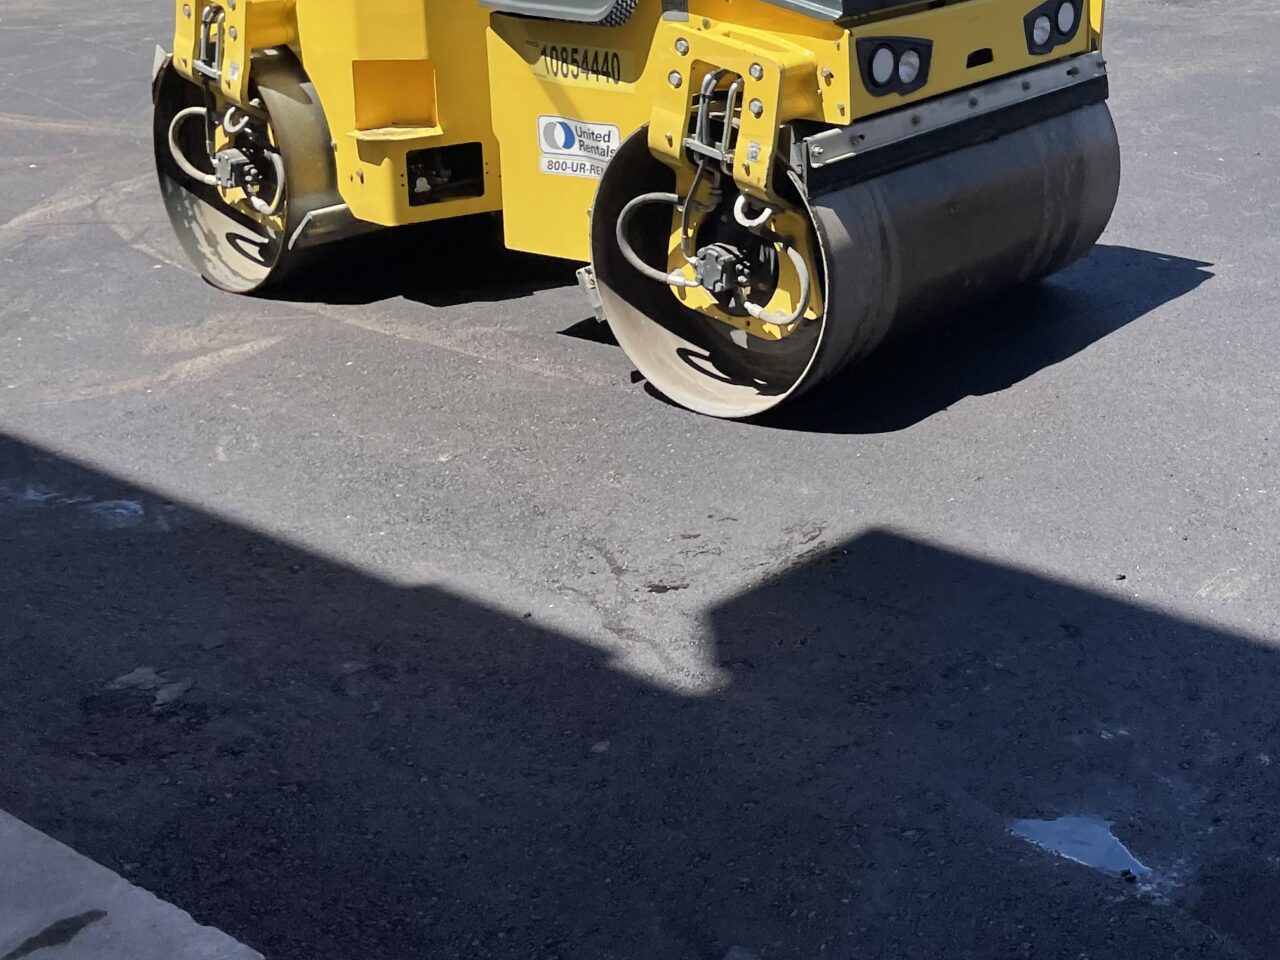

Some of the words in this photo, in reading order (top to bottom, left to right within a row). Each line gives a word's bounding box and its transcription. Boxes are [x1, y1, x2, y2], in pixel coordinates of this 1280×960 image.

[540, 44, 621, 85] 10854440
[575, 125, 611, 143] United
[578, 139, 617, 158] Rentals
